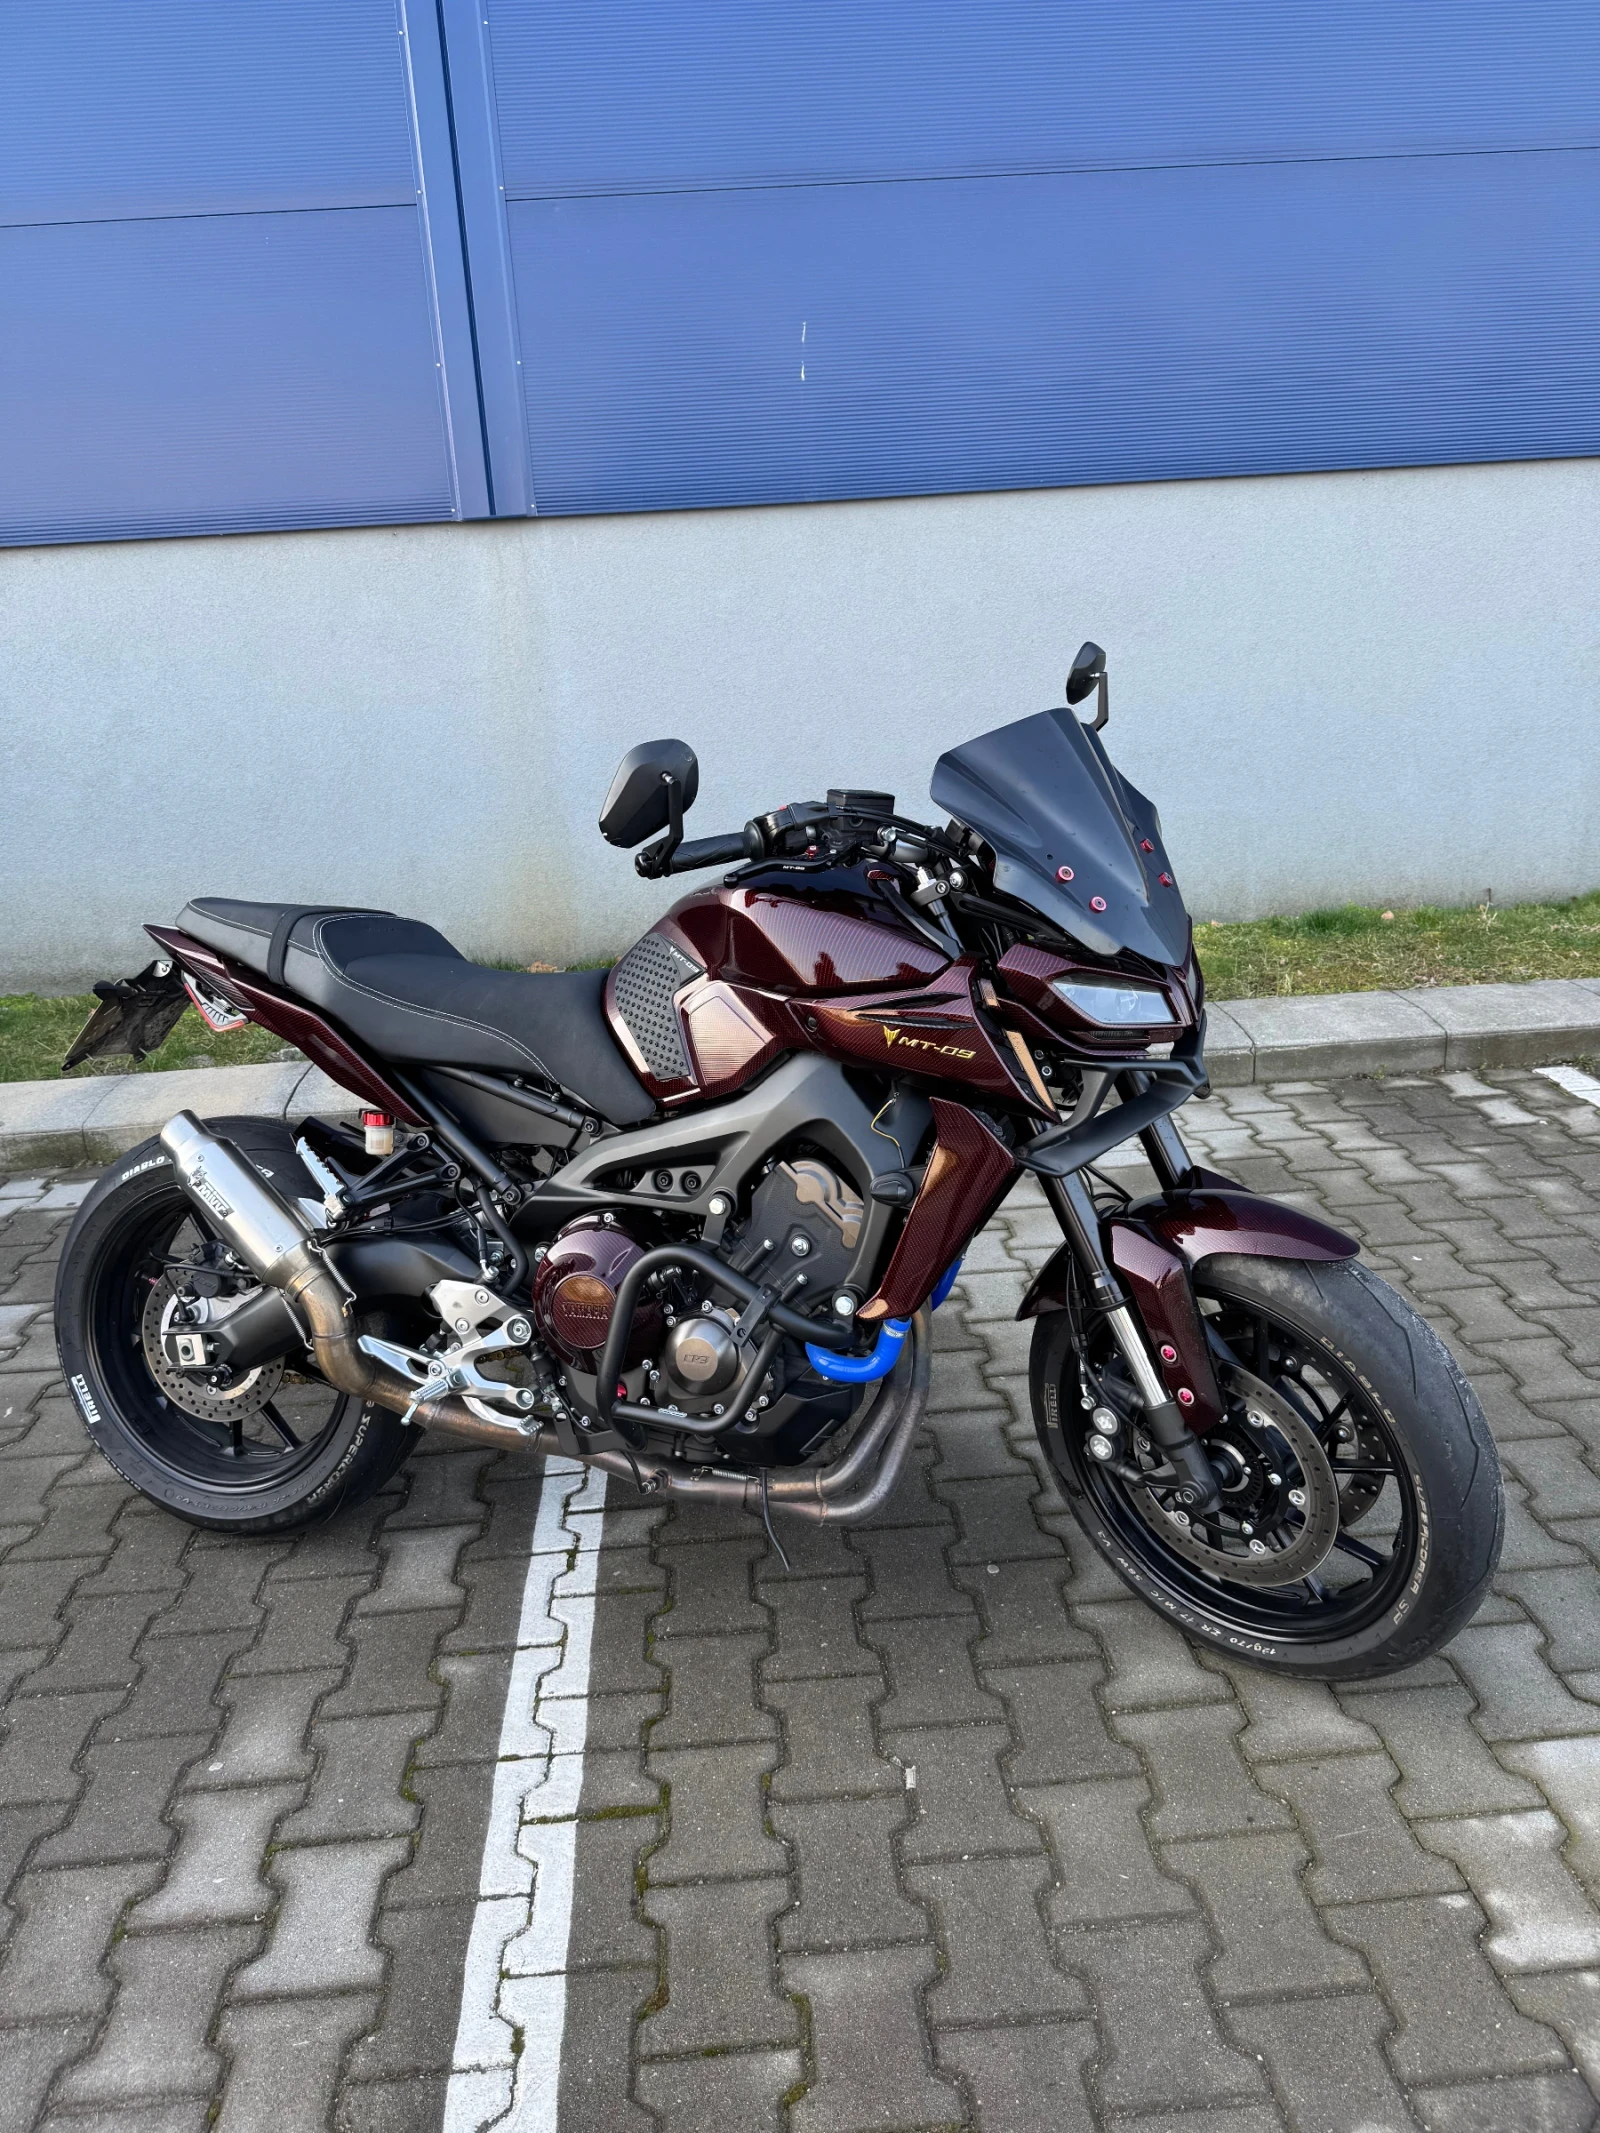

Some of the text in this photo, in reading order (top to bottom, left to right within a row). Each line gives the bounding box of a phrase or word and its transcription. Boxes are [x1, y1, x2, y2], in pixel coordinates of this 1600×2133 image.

[672, 950, 700, 973] MT-09
[898, 1036, 977, 1060] MT-09
[121, 1156, 165, 1180] DIABLO
[561, 1301, 609, 1319] YAMAHA
[71, 1374, 100, 1424] PIRELLI
[1044, 1382, 1058, 1429] PIRELLI
[306, 1413, 372, 1504] SUPERCORSA
[1321, 1336, 1396, 1424] DIABLO
[1411, 1473, 1429, 1596] SUPERCORSA
